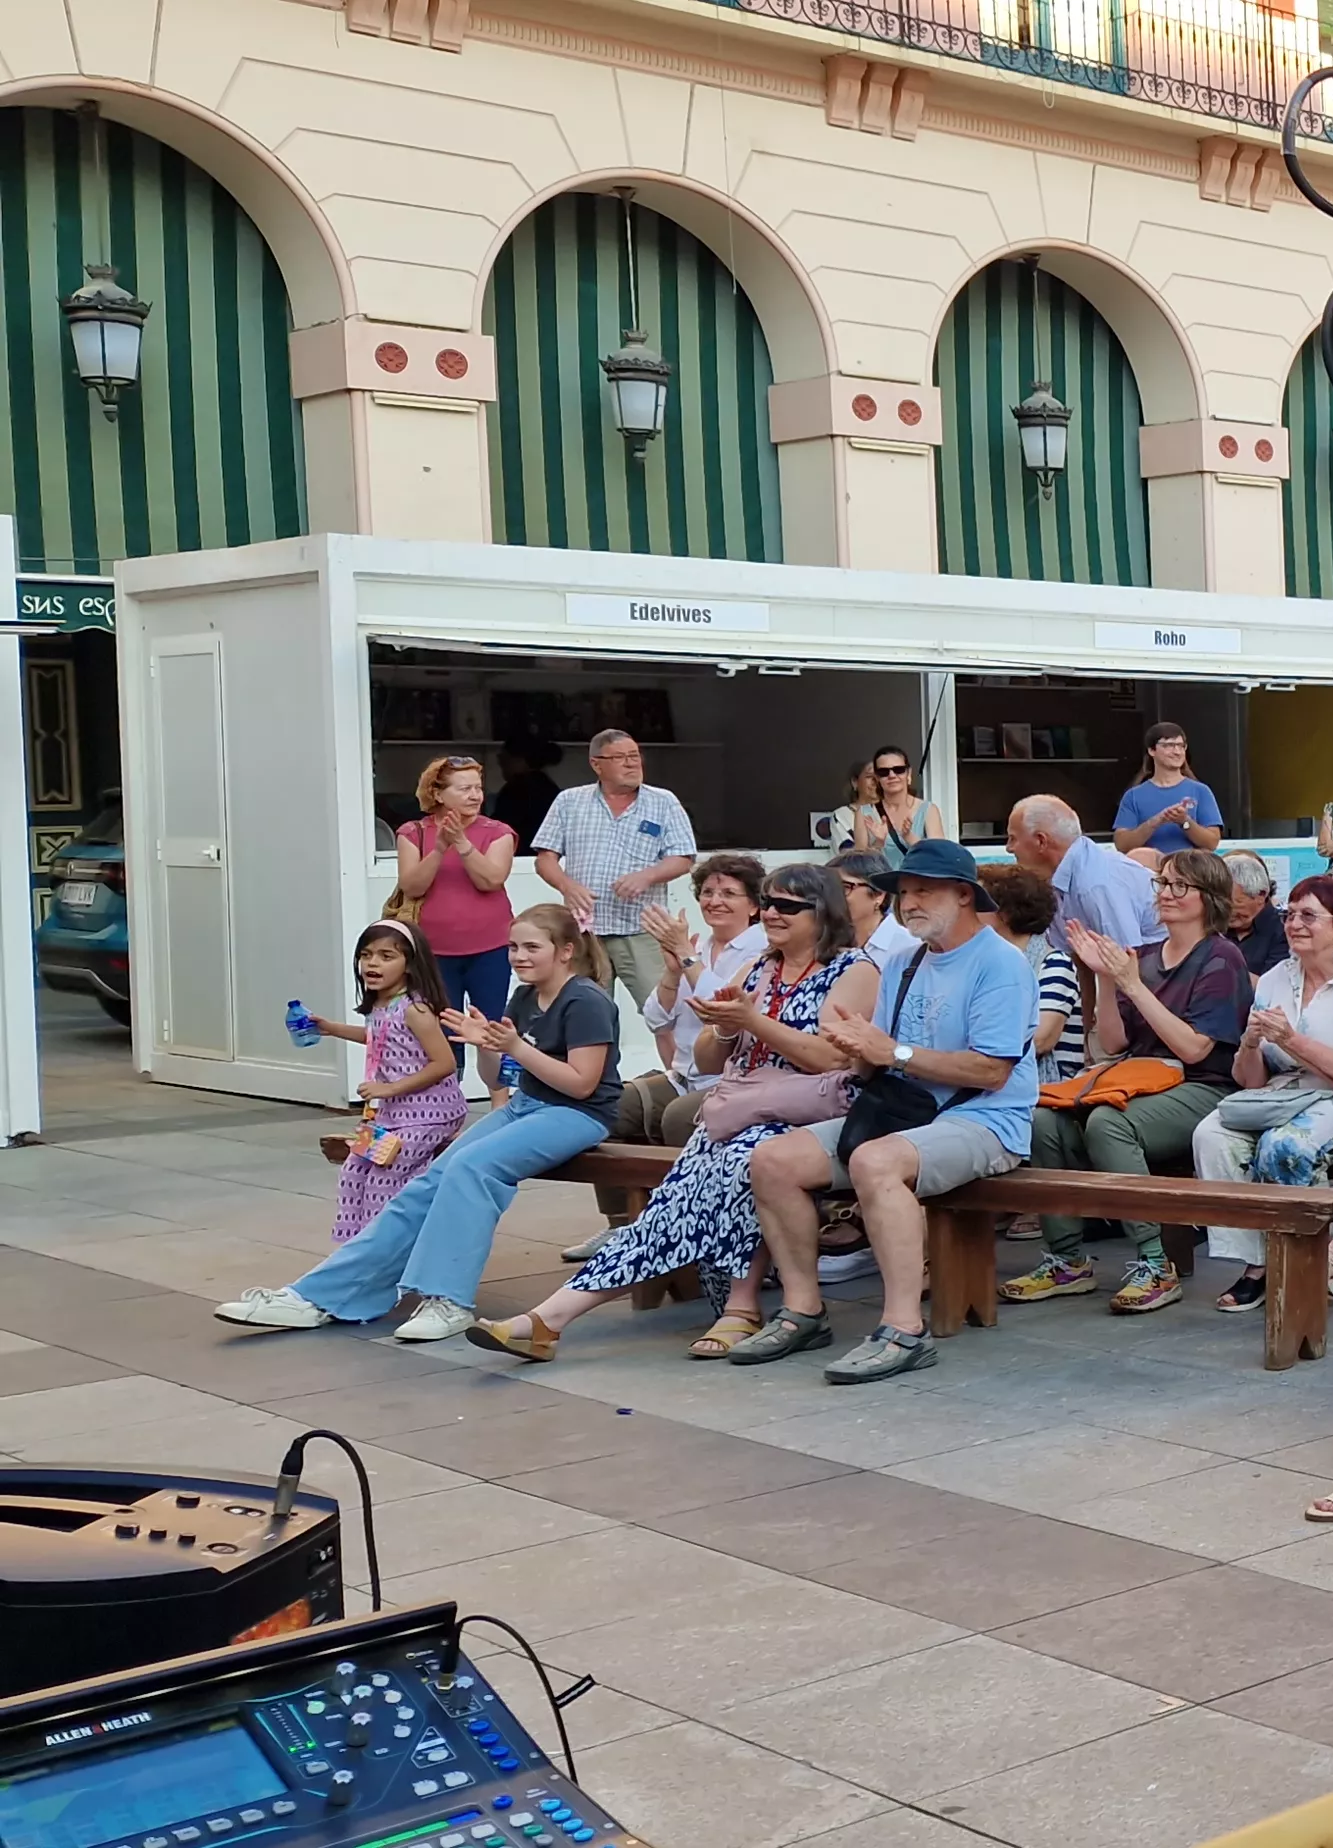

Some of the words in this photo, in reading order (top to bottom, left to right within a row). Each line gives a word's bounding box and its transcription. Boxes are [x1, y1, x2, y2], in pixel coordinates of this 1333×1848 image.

[21, 595, 65, 615] sus
[79, 597, 116, 626] esp
[629, 602, 712, 623] Edelvives
[1154, 630, 1186, 646] Roho
